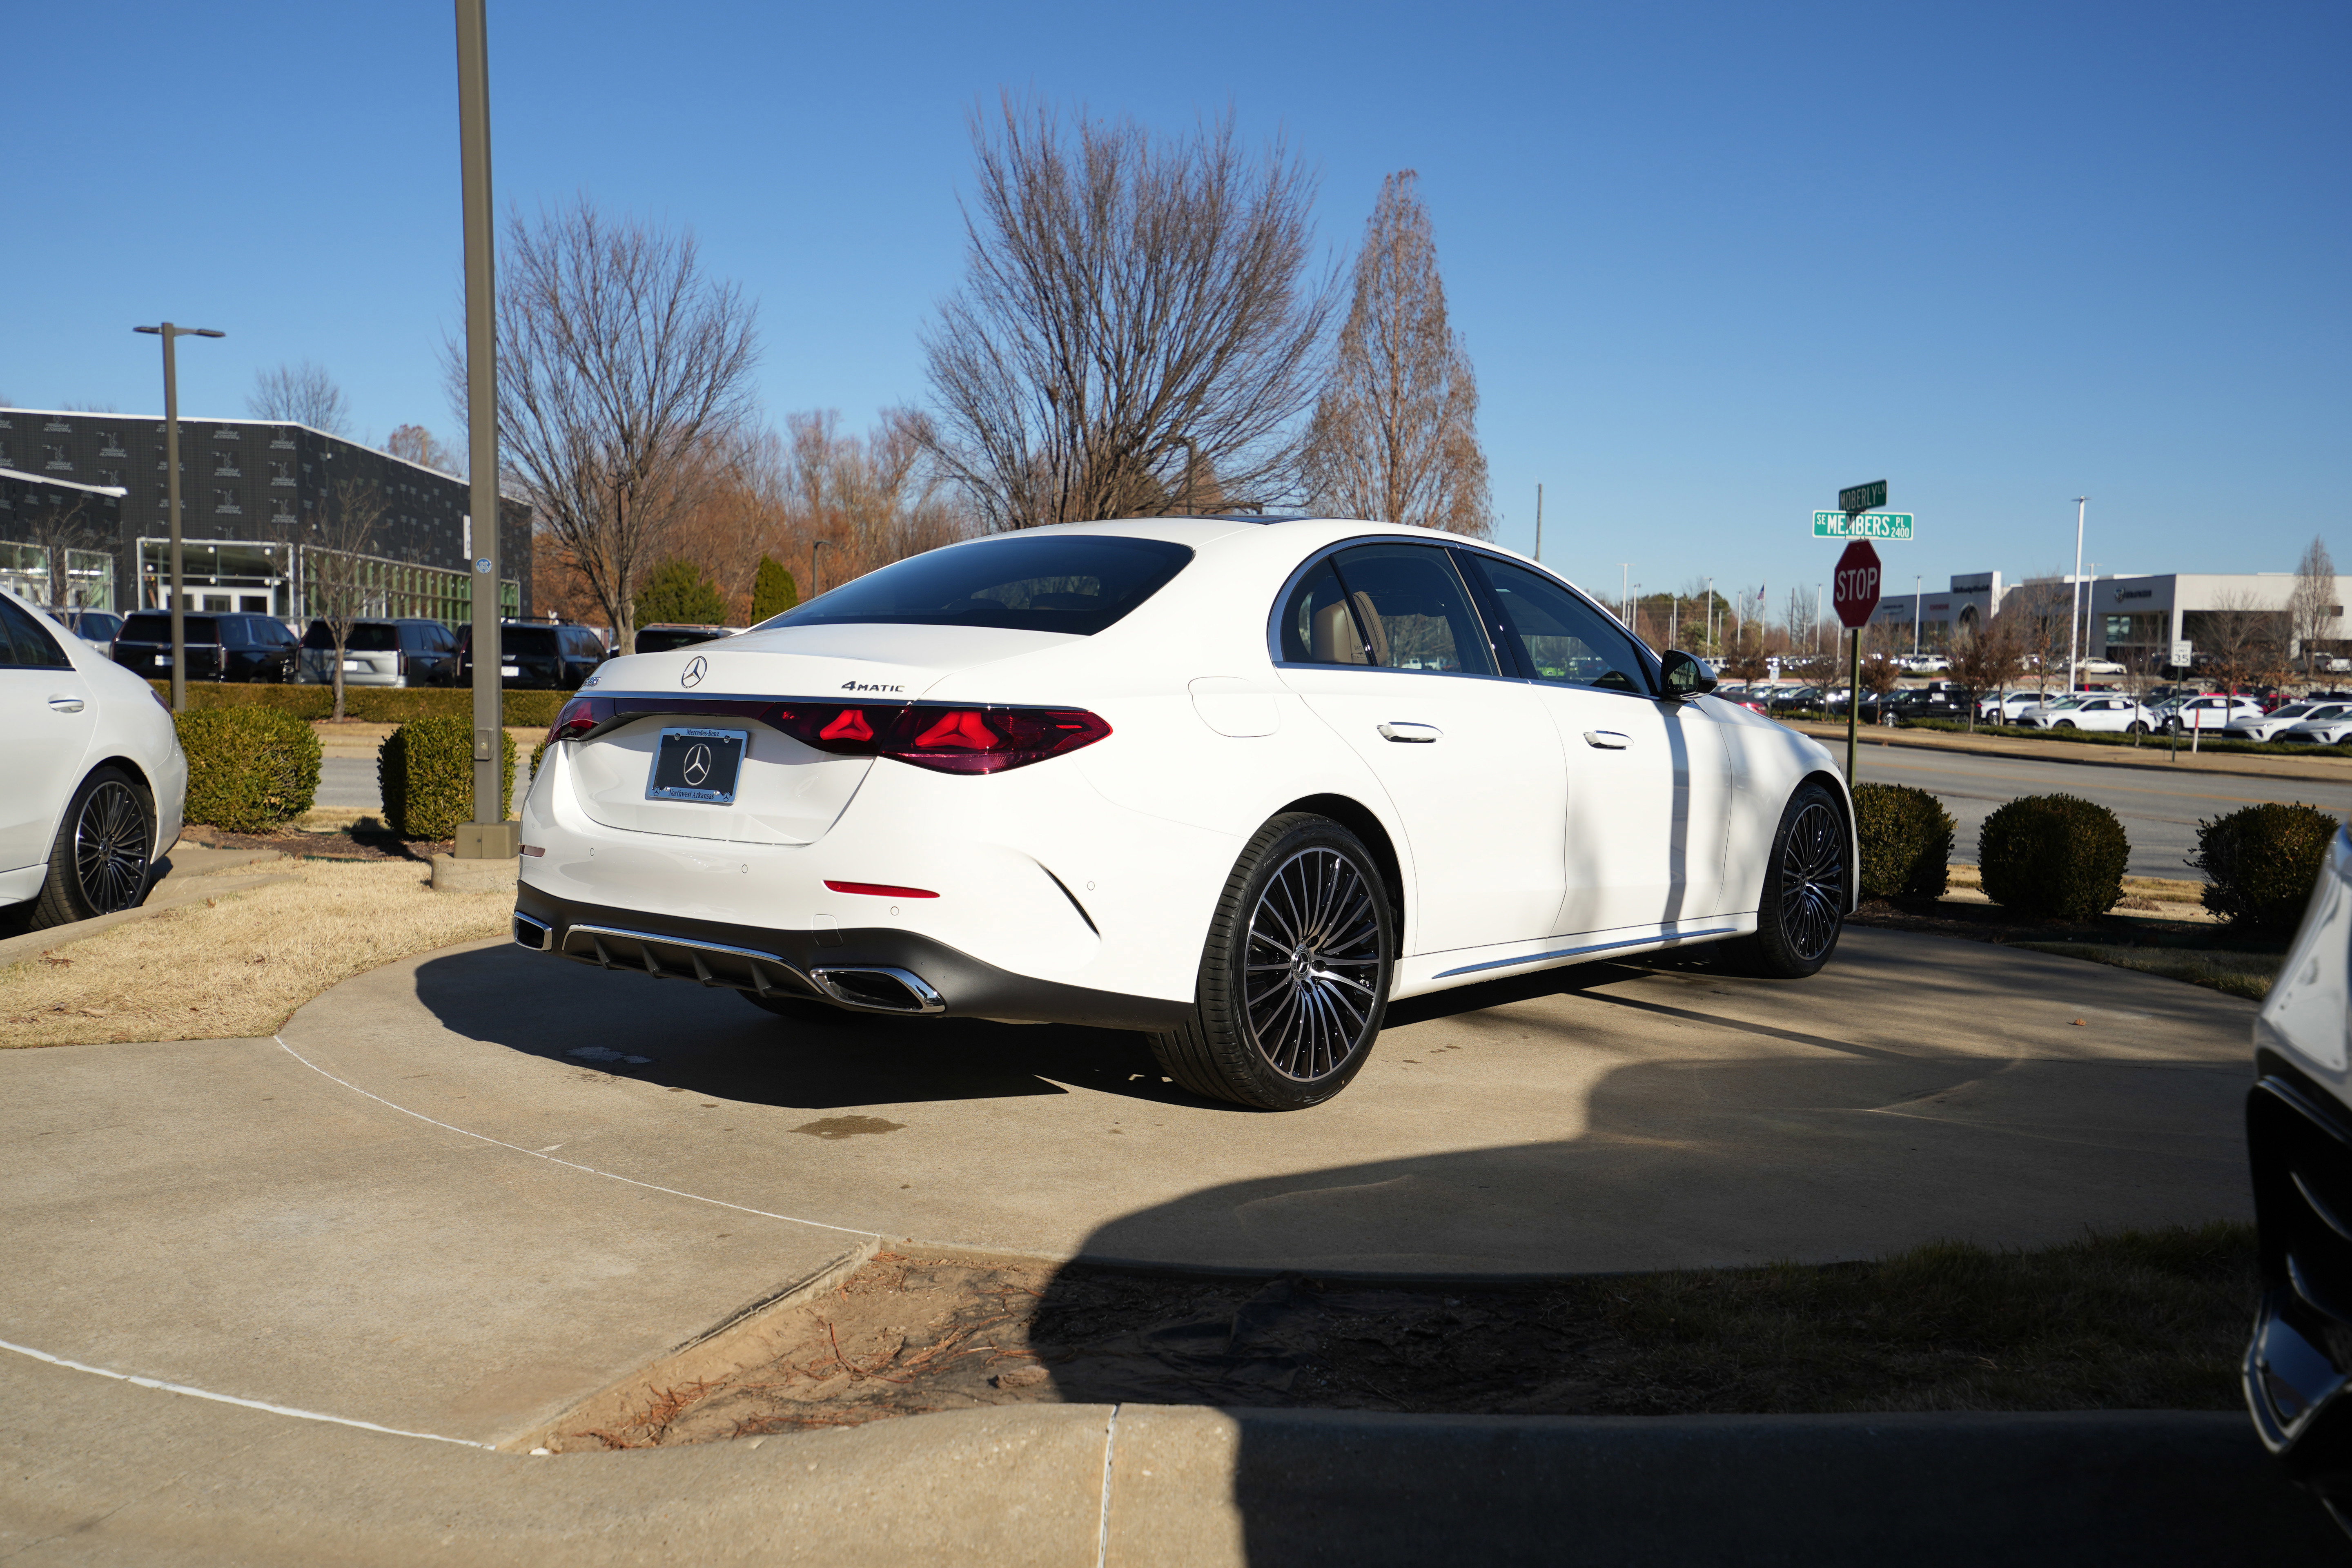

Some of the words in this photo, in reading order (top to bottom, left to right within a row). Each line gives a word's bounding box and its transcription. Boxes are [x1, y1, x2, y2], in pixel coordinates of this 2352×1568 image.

[1840, 485, 1877, 510] MOBERLY
[1878, 483, 1885, 494] LN
[1817, 514, 1826, 525] SE
[1827, 514, 1890, 536] MEMBERS
[1896, 517, 1905, 527] PL
[1891, 527, 1909, 538] 2400
[1836, 567, 1878, 602] STOP
[2174, 654, 2189, 663] 35
[841, 681, 905, 692] 4MATIC
[668, 789, 692, 798] Northwest
[692, 791, 715, 800] Arkansas
